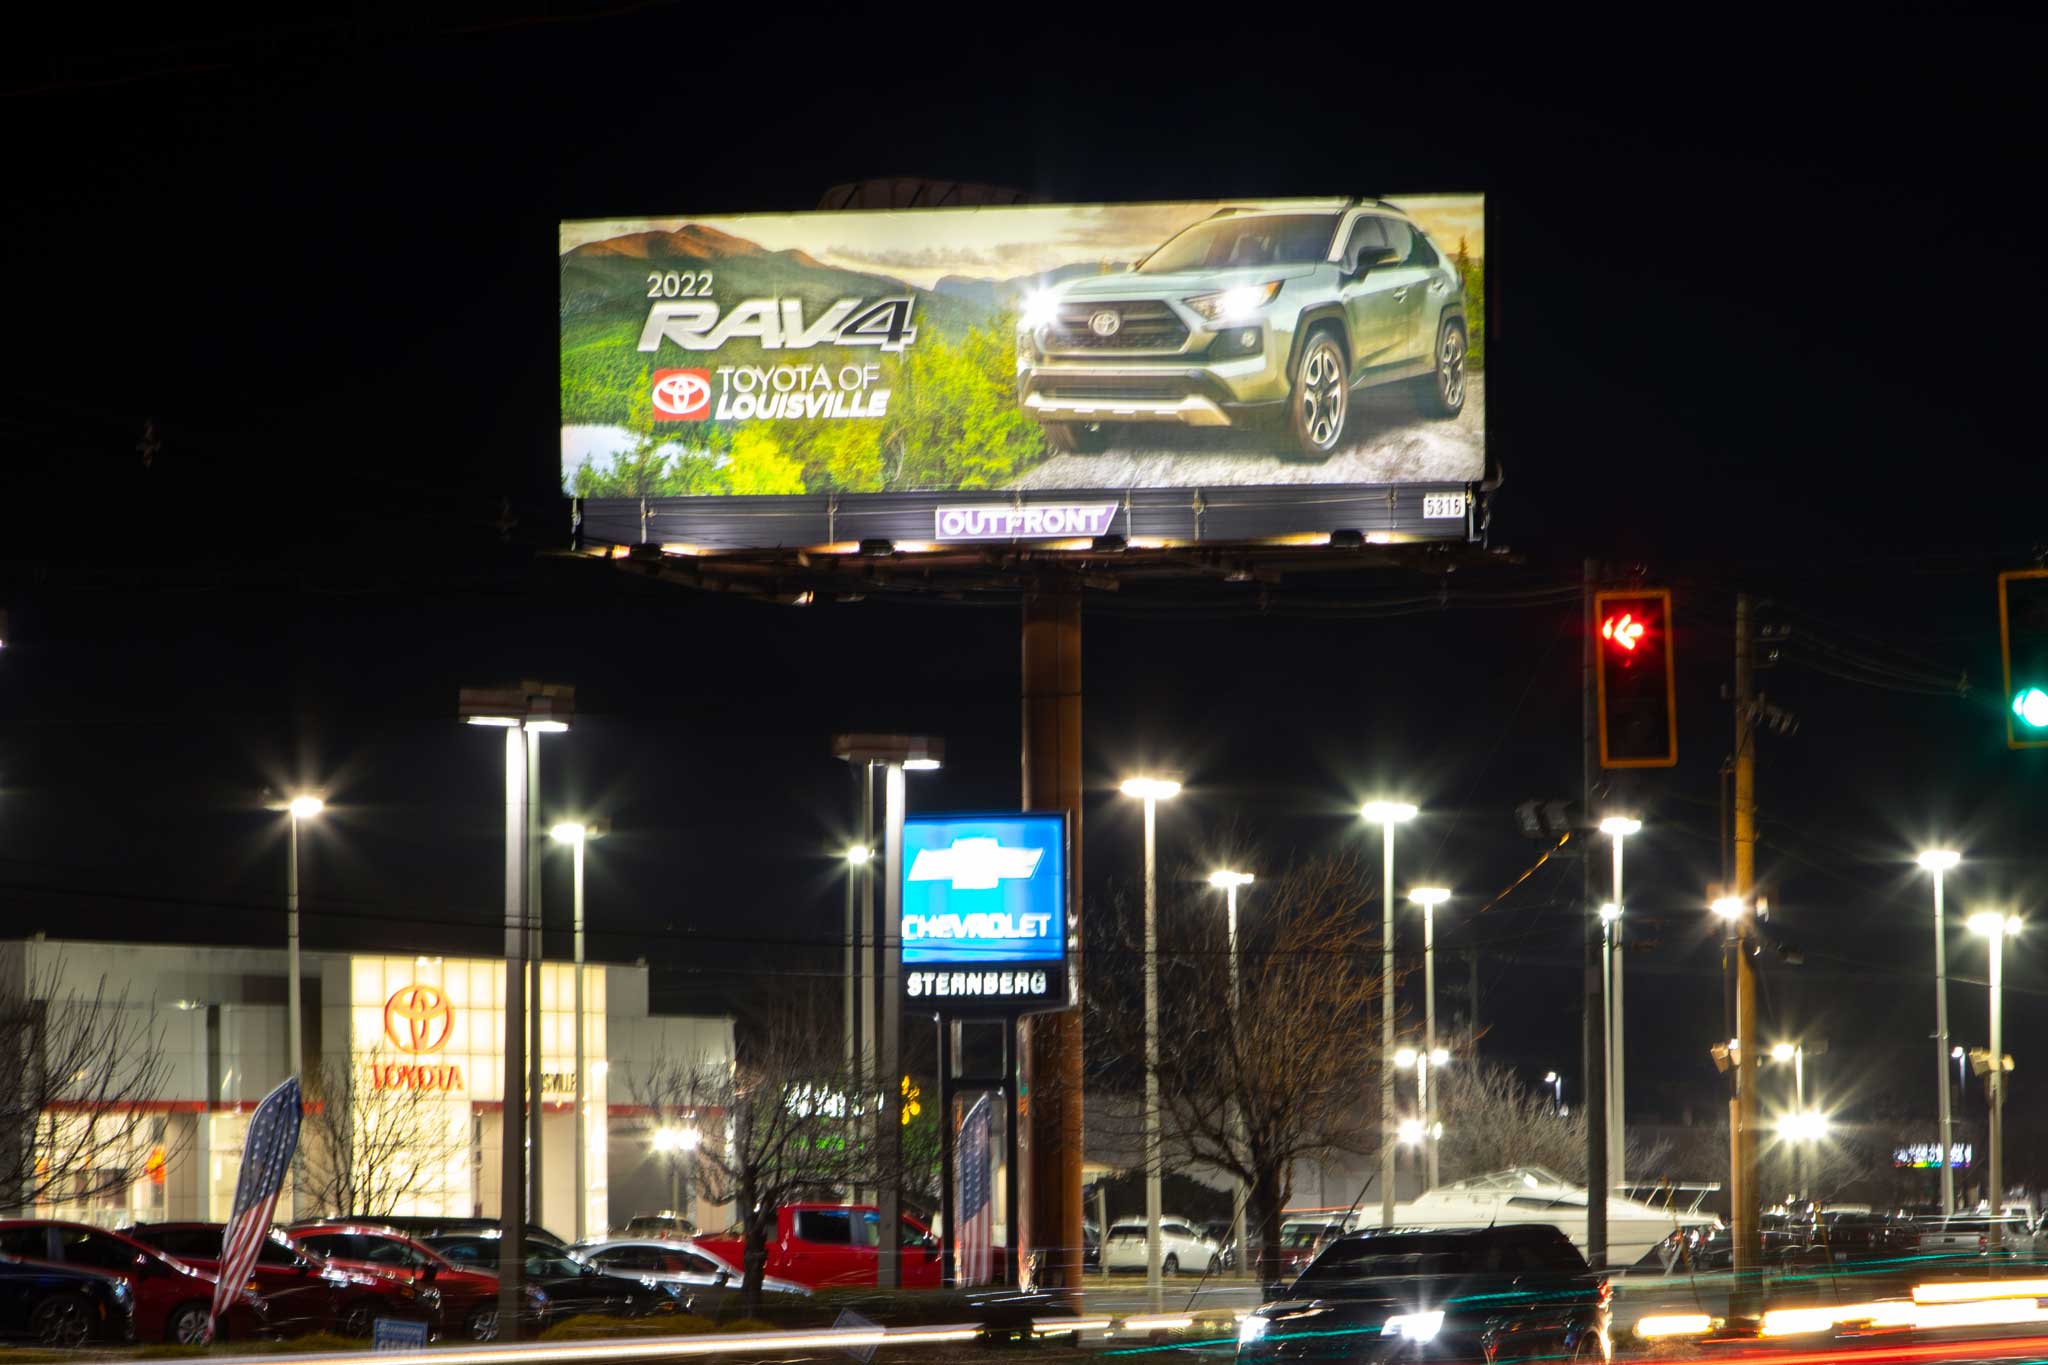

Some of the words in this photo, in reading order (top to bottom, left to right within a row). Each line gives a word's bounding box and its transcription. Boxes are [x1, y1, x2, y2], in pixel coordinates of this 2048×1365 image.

[647, 270, 714, 298] 2022
[637, 296, 918, 352] RAV4
[716, 363, 832, 392] TOYOTA
[838, 361, 881, 391] OF
[715, 390, 891, 420] LOUISVILLE
[942, 507, 1107, 535] OUTFRONT
[902, 913, 1051, 940] CHEVROLET
[907, 971, 1047, 997] STERNBERG
